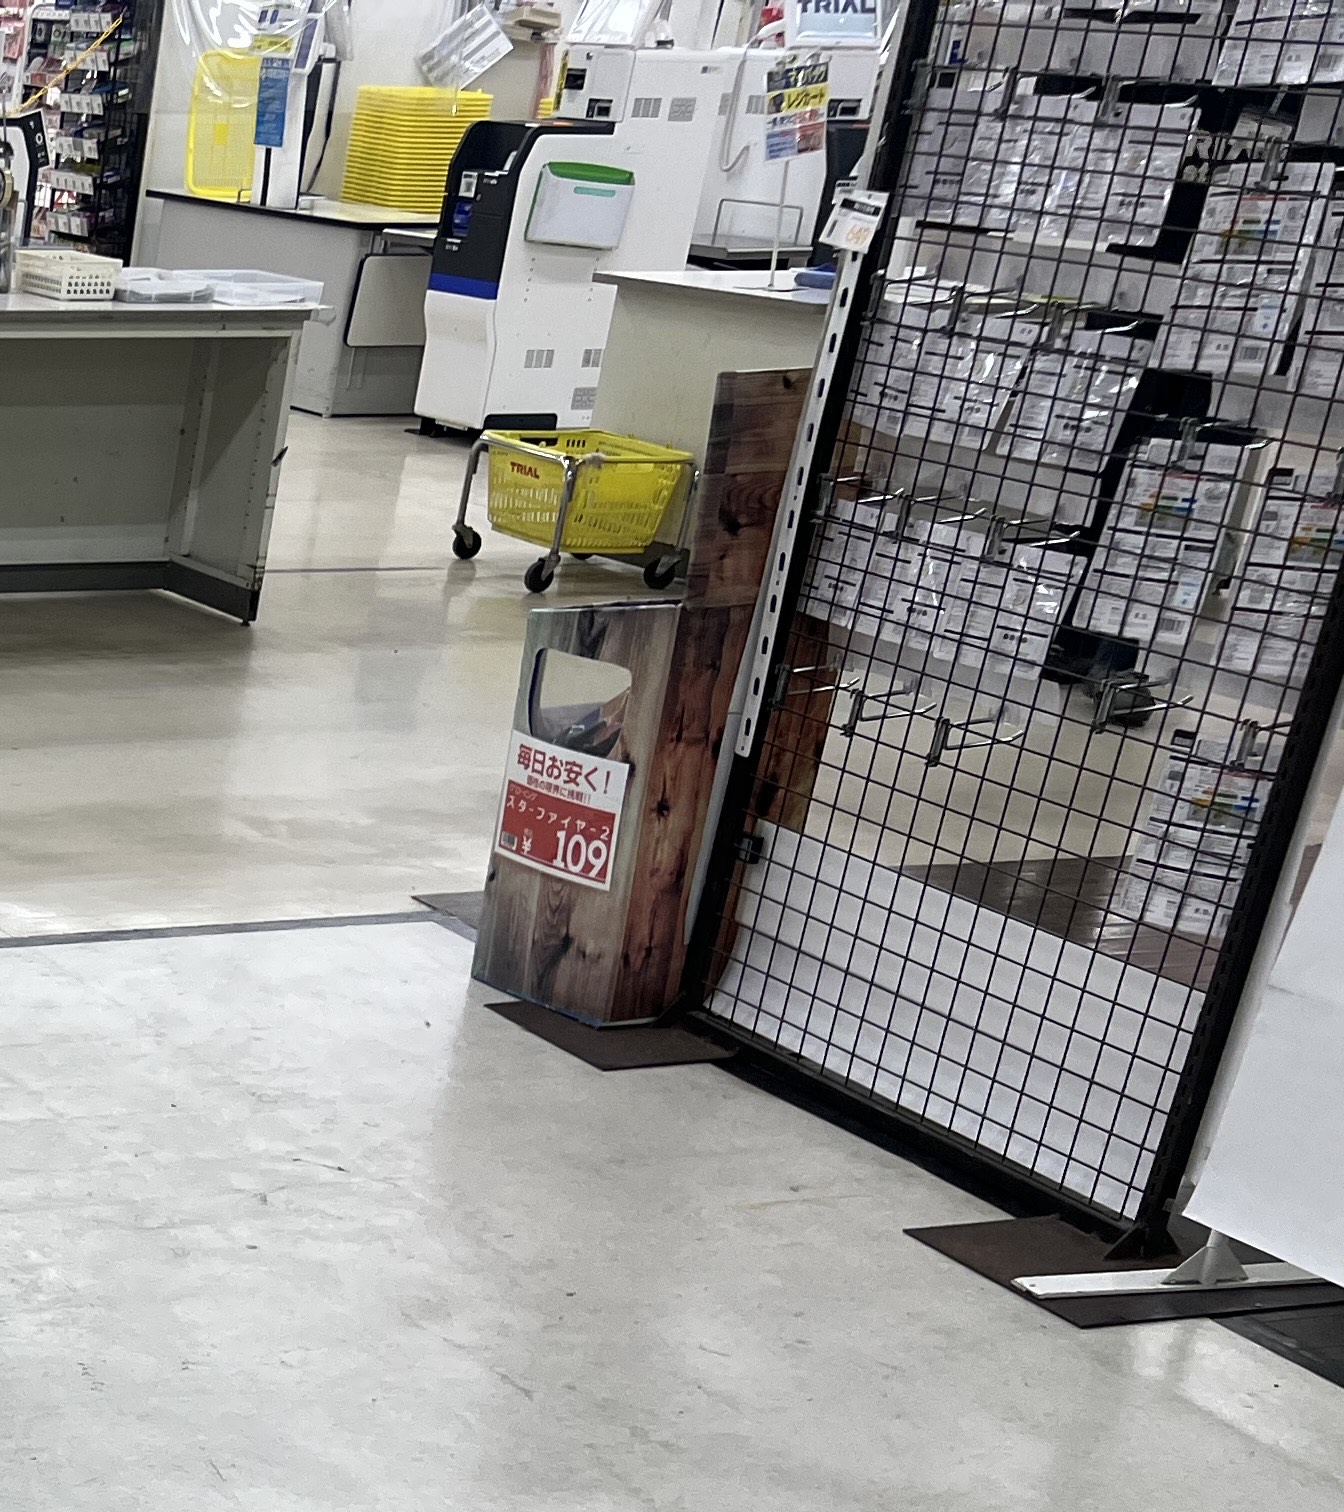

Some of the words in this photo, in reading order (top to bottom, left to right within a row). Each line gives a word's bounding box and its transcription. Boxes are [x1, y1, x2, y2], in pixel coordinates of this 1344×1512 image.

[510, 461, 540, 480] TRIAL
[516, 743, 611, 795] 毎日お安く!
[552, 829, 608, 878] 109
